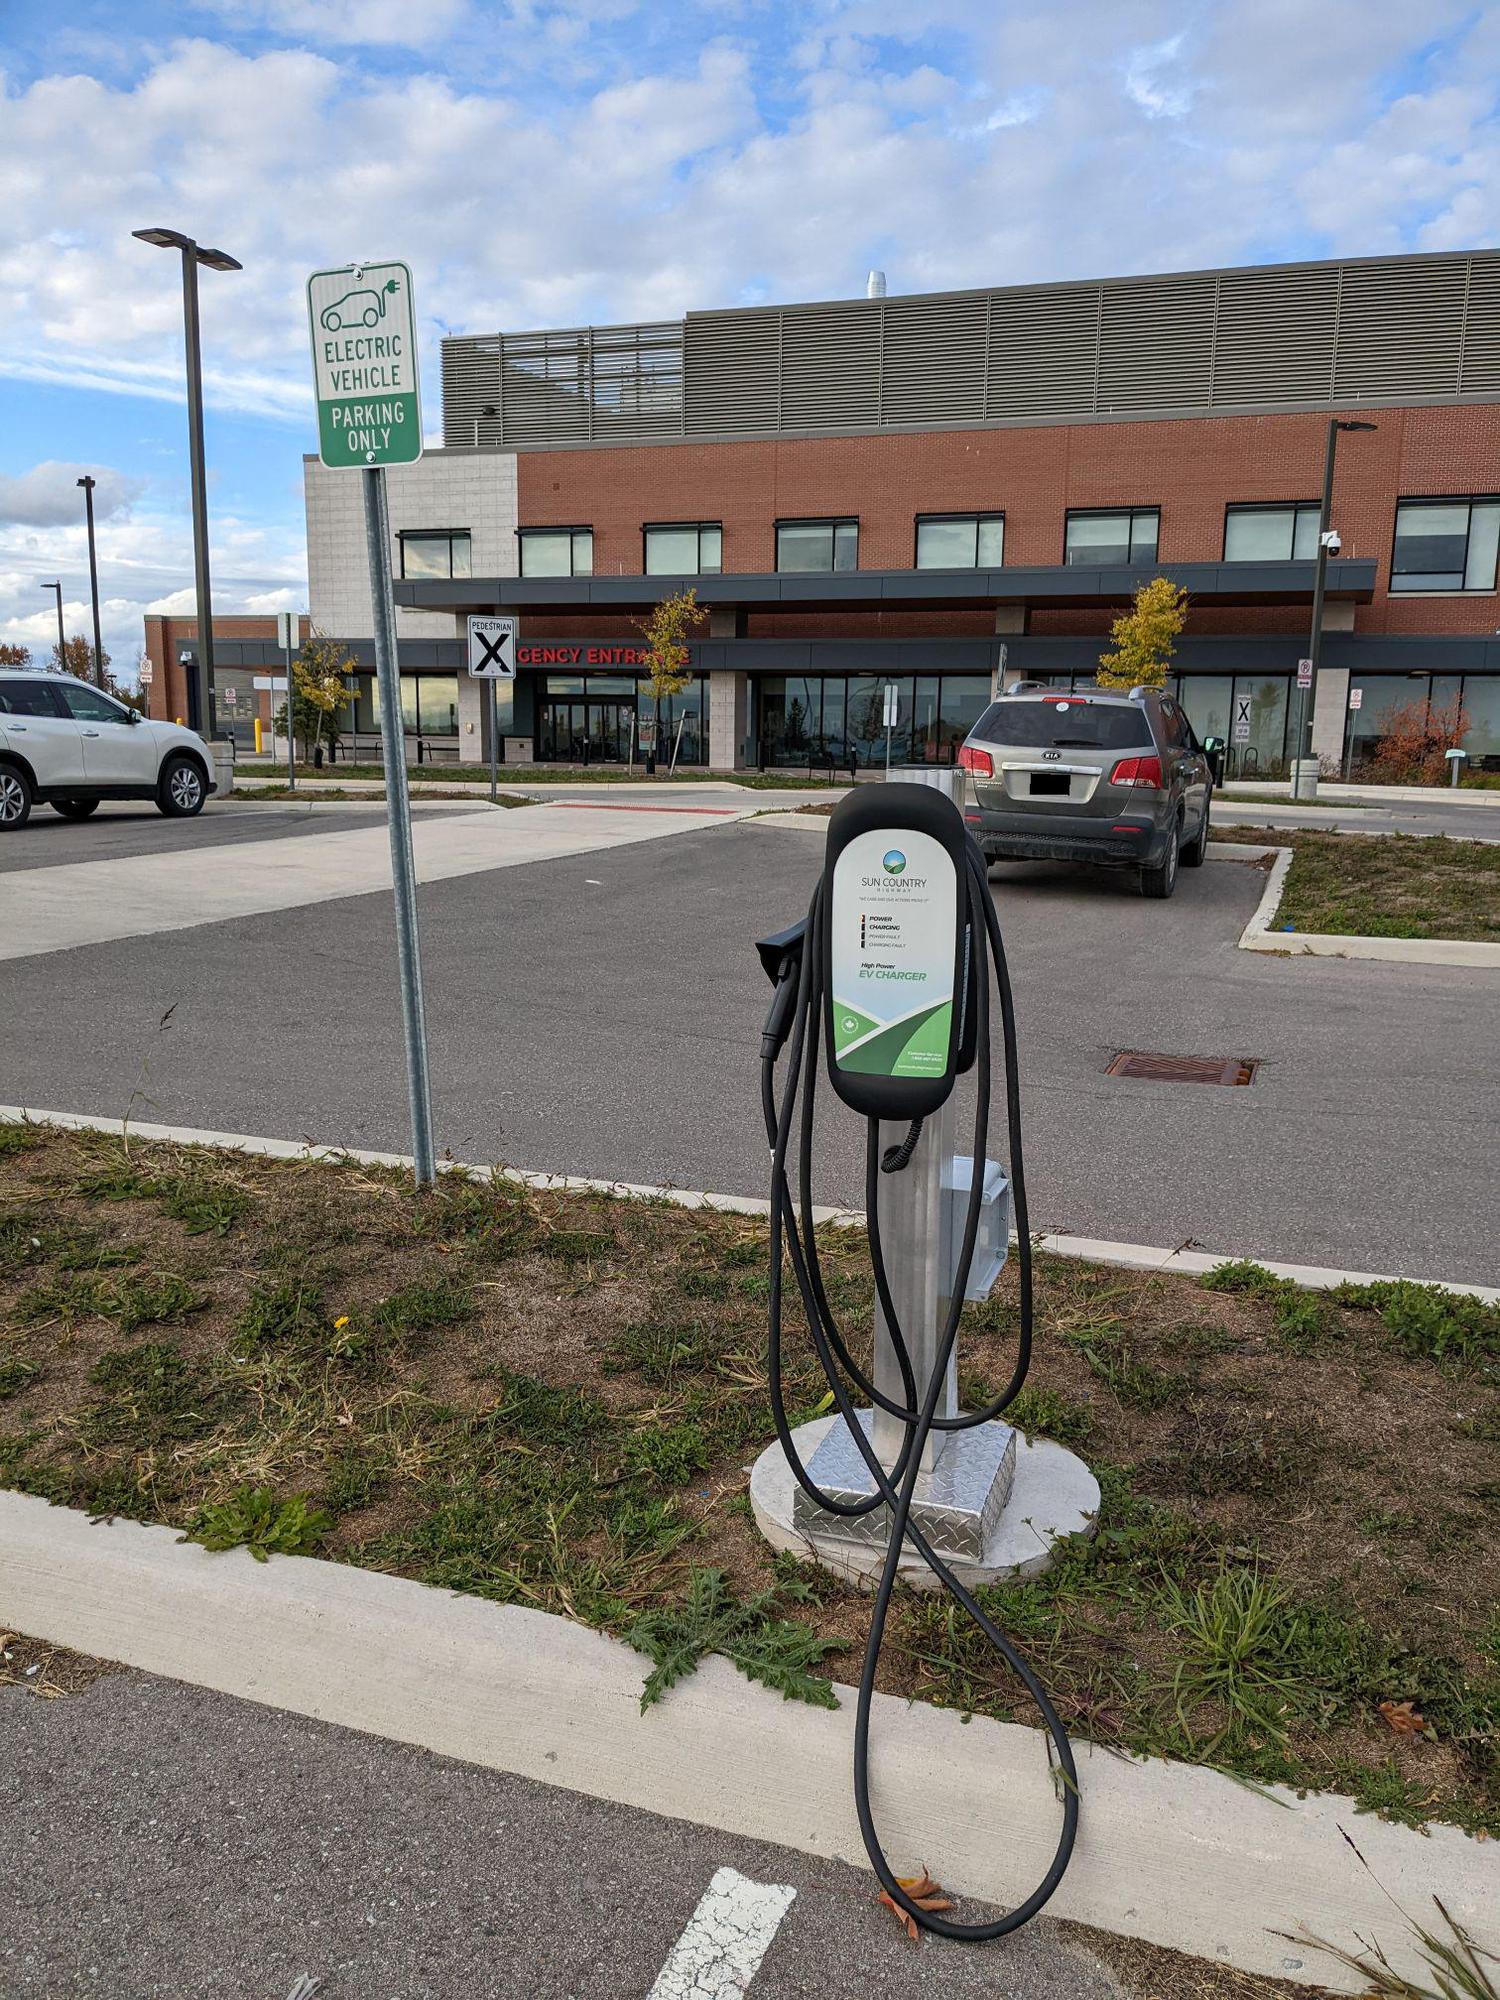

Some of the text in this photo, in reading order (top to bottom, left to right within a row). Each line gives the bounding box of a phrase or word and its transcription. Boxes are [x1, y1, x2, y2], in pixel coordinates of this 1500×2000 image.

[324, 334, 402, 363] ELECTRIC
[330, 365, 401, 392] VEHICLE
[332, 401, 405, 429] PARKING
[348, 428, 391, 451] ONLY
[471, 621, 512, 632] PEDESTRIAN
[474, 632, 511, 673] X
[516, 646, 581, 665] GENCY
[861, 877, 927, 888] SUN COUNTRY
[859, 969, 927, 981] EV CHARGER
